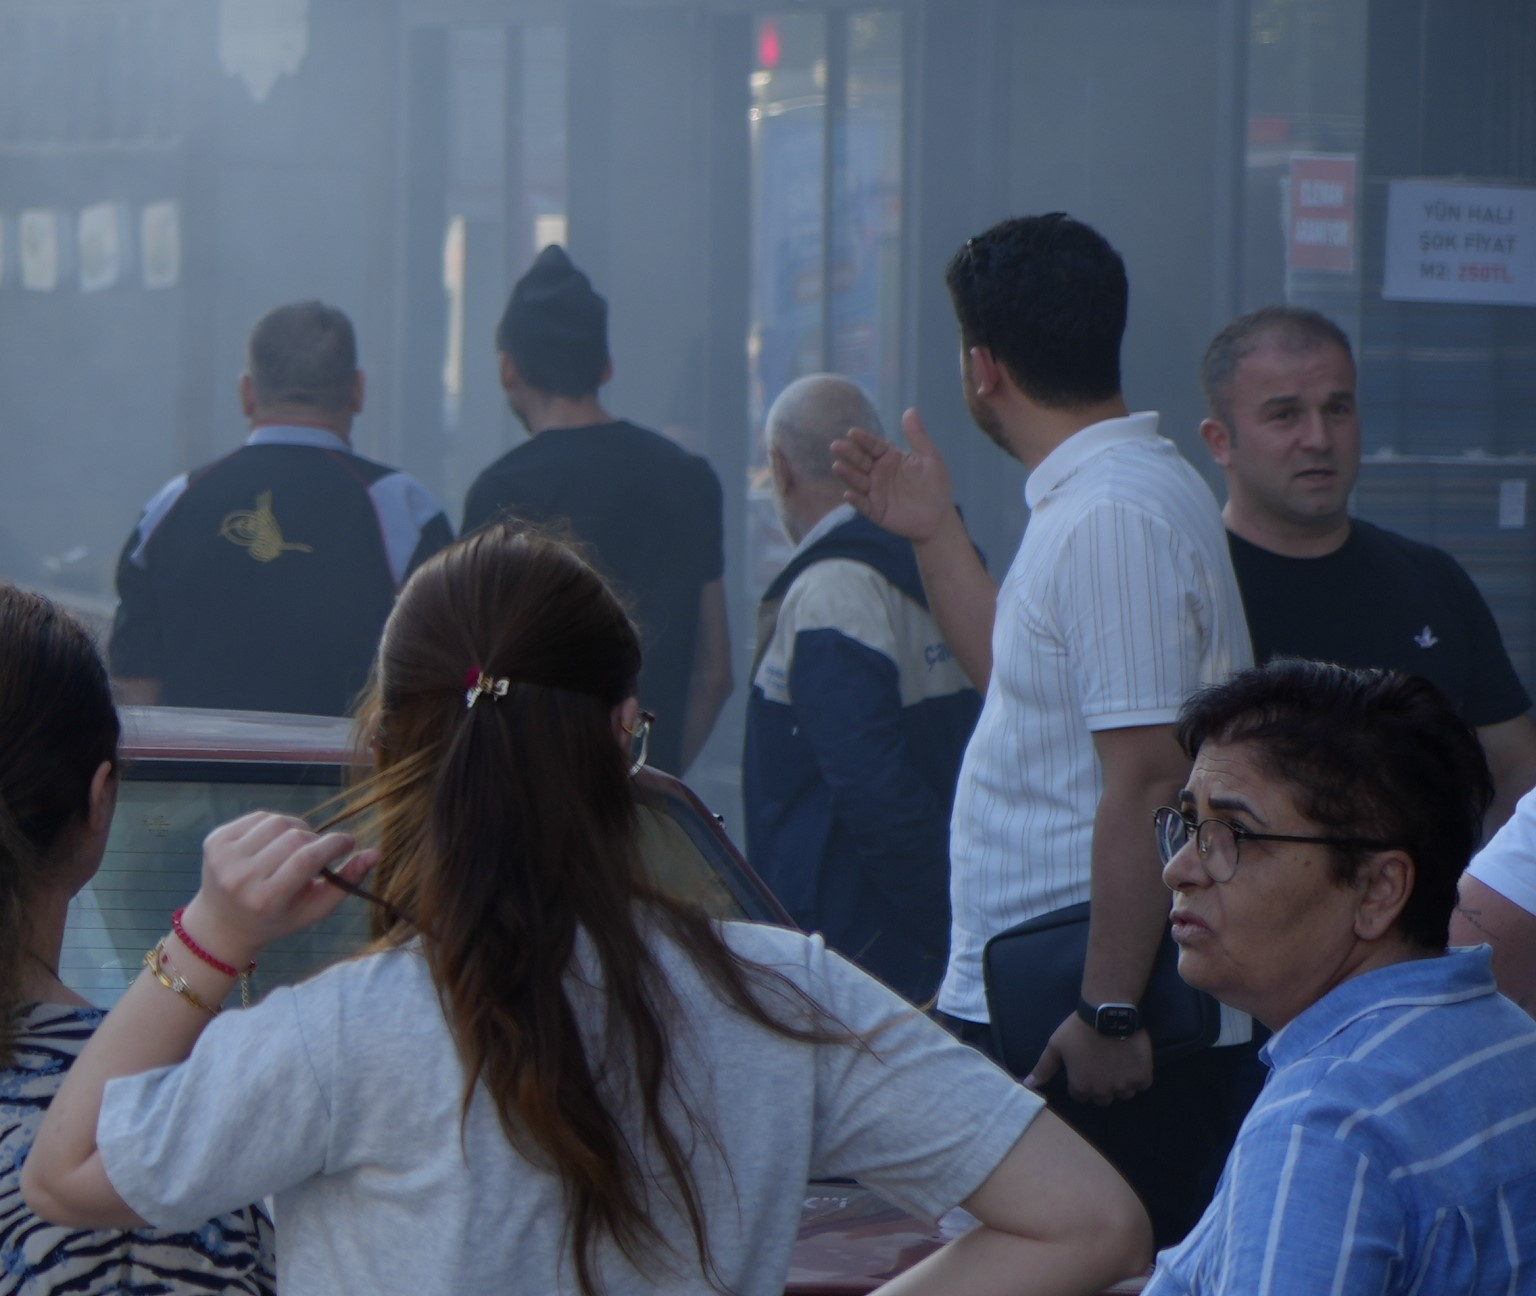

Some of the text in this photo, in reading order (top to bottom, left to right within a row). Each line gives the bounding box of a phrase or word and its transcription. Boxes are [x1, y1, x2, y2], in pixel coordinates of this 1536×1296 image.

[1423, 199, 1515, 225] YÜN HALI
[1464, 232, 1517, 254] FİYAT
